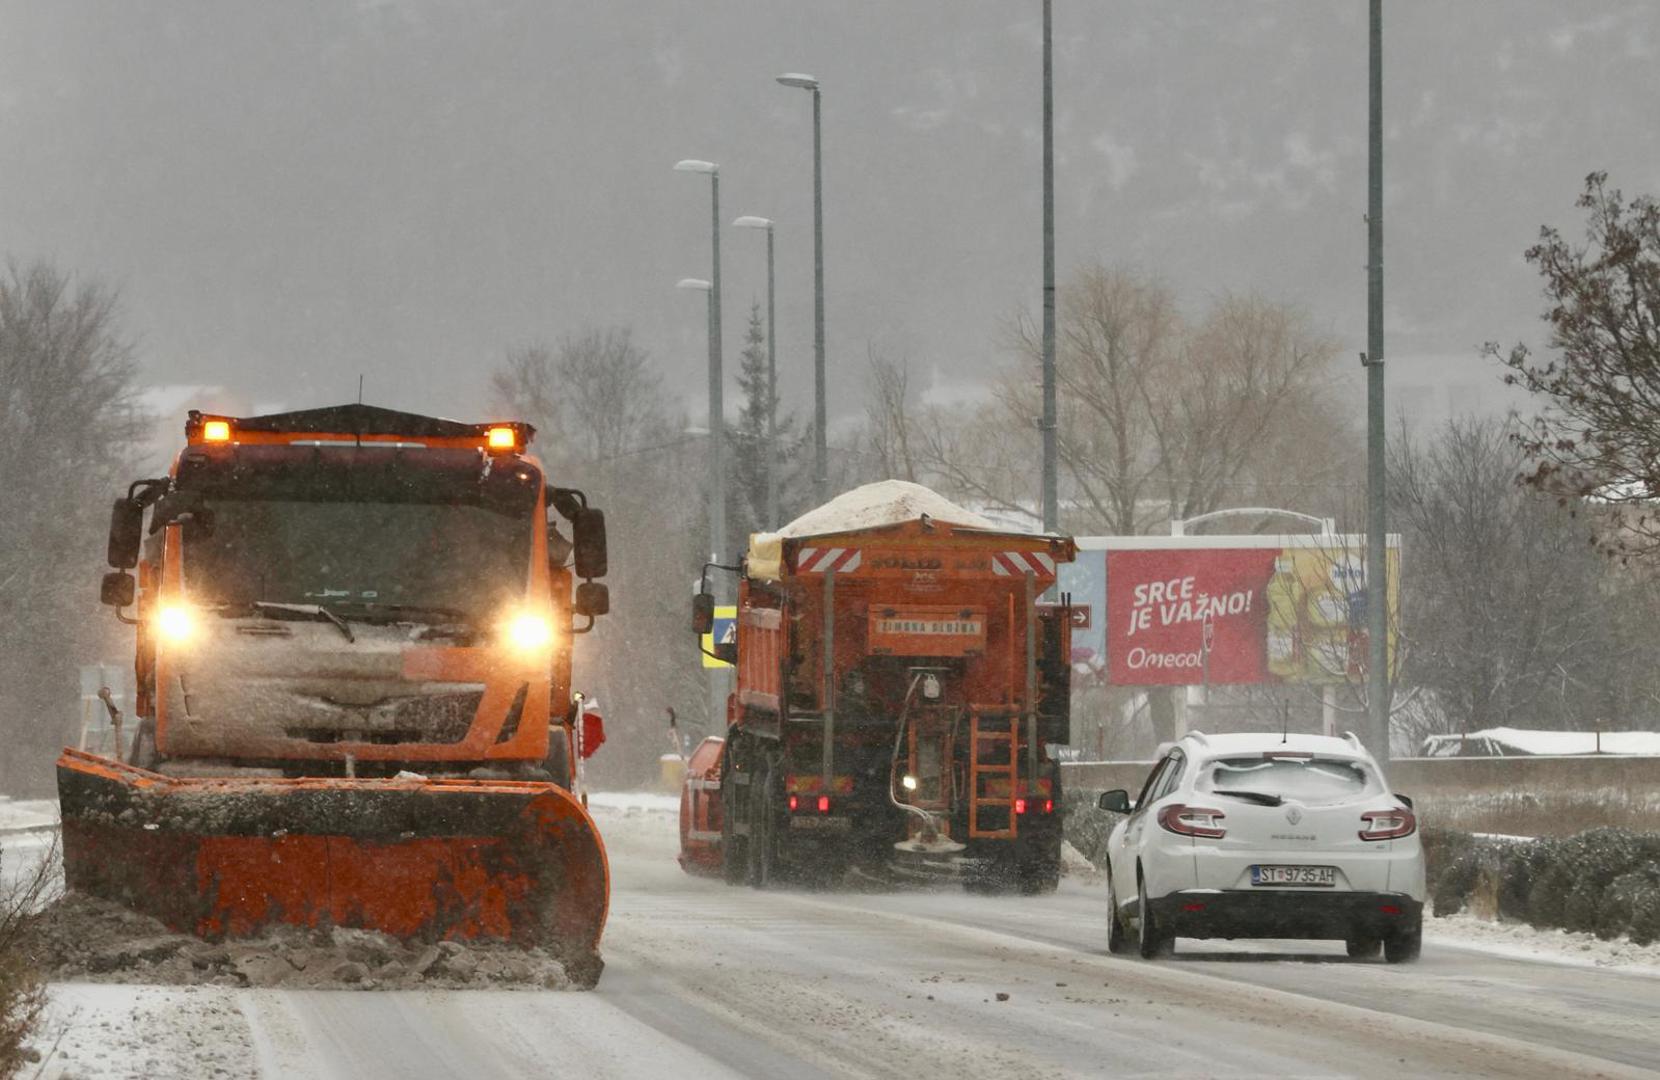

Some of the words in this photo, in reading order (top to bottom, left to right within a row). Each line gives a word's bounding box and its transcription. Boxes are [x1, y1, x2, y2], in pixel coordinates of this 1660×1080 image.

[1133, 576, 1195, 607] SRCE
[1127, 606, 1152, 636] JE
[1160, 589, 1253, 625] VAŽNO!
[1261, 868, 1276, 882] ST
